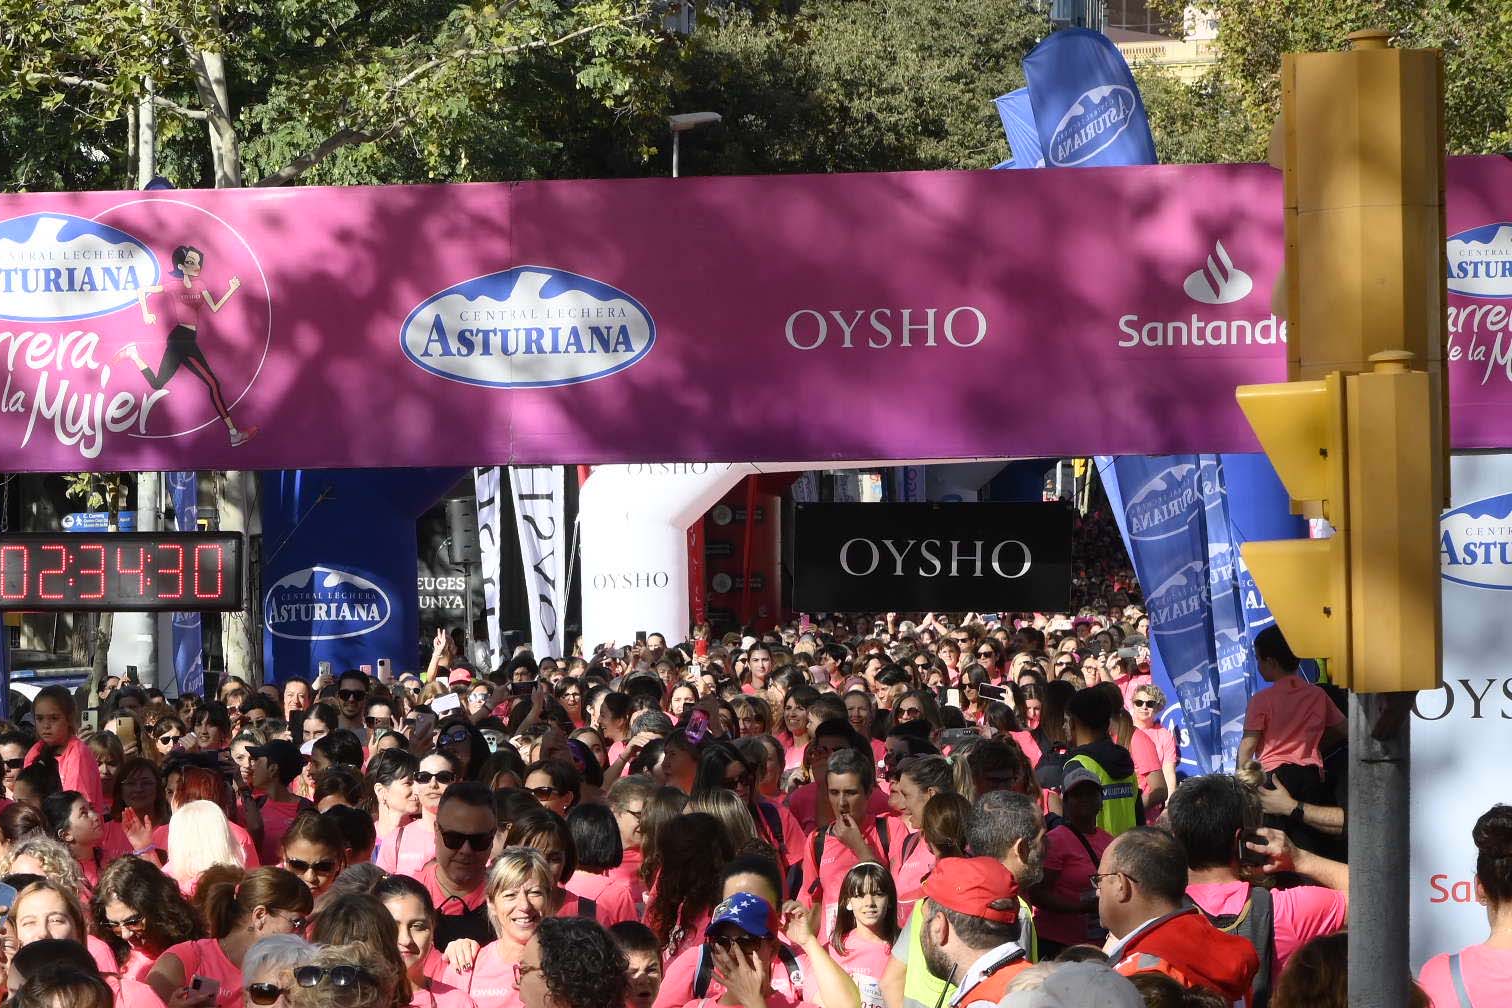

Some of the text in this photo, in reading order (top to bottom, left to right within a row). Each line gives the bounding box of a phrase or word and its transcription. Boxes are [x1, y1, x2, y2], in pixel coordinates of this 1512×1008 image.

[63, 249, 135, 261] LECHERA
[459, 306, 627, 321] CENTRAL LECHERA
[785, 305, 987, 350] OYSHO
[420, 312, 636, 358] ASTURIANA
[1468, 334, 1486, 361] la
[0, 373, 26, 413] la
[20, 362, 169, 459] Mujer
[0, 544, 224, 600] 02:34:30
[839, 538, 1032, 579] OYSHO
[593, 571, 669, 591] OYSHO
[268, 600, 381, 625] ASTURIANA
